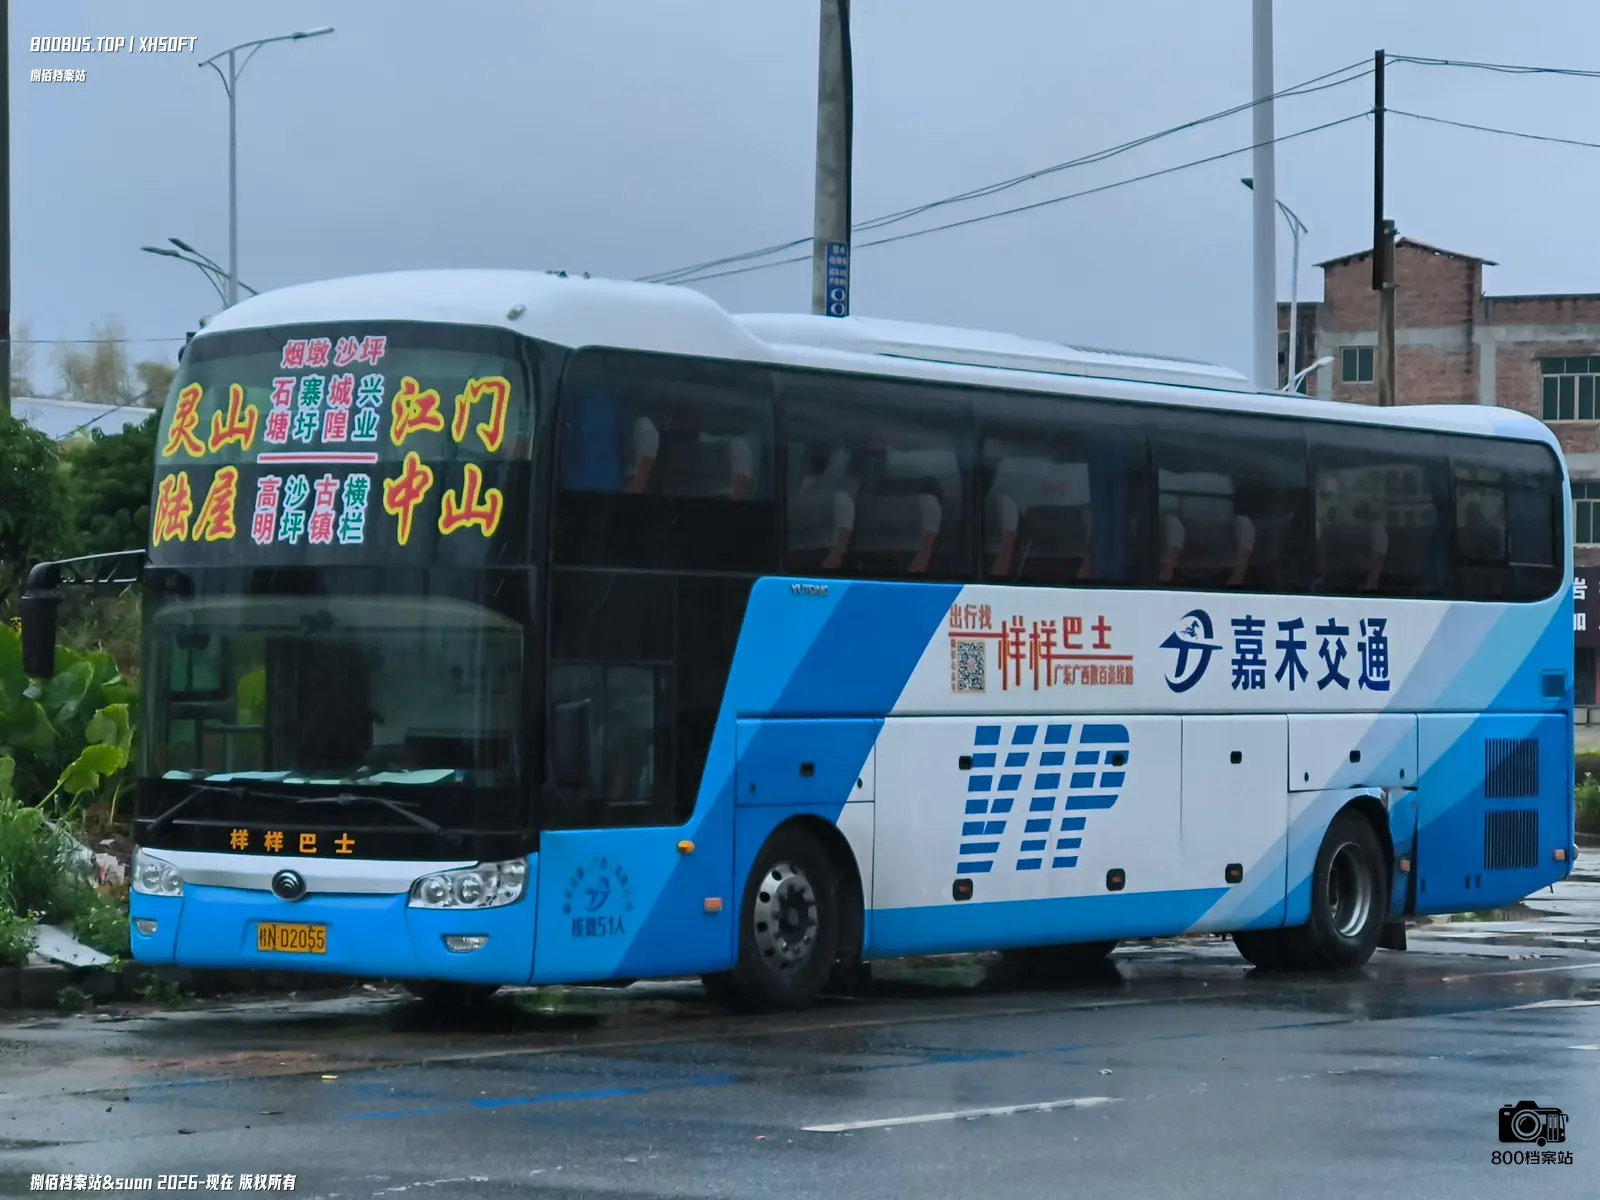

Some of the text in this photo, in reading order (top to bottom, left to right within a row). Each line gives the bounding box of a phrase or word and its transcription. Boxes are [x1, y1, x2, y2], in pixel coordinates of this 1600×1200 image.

[280, 335, 387, 369] 烟墩 沙坪
[162, 382, 259, 458] 灵山
[264, 376, 297, 443] 石塘
[292, 374, 325, 443] 寨圩
[321, 373, 355, 443] 城隍
[350, 373, 385, 441] 兴业
[390, 376, 511, 453] 江门
[152, 465, 238, 548] 陆屋
[251, 475, 282, 545] 高明
[278, 474, 310, 544] 沙坪
[307, 473, 340, 544] 古镇
[337, 473, 370, 544] 横栏
[383, 452, 503, 546] 中山
[949, 602, 992, 630] 出行找
[1231, 614, 1392, 692] 嘉禾交通
[956, 723, 1130, 875] VIP
[230, 828, 356, 854] 样样巴士
